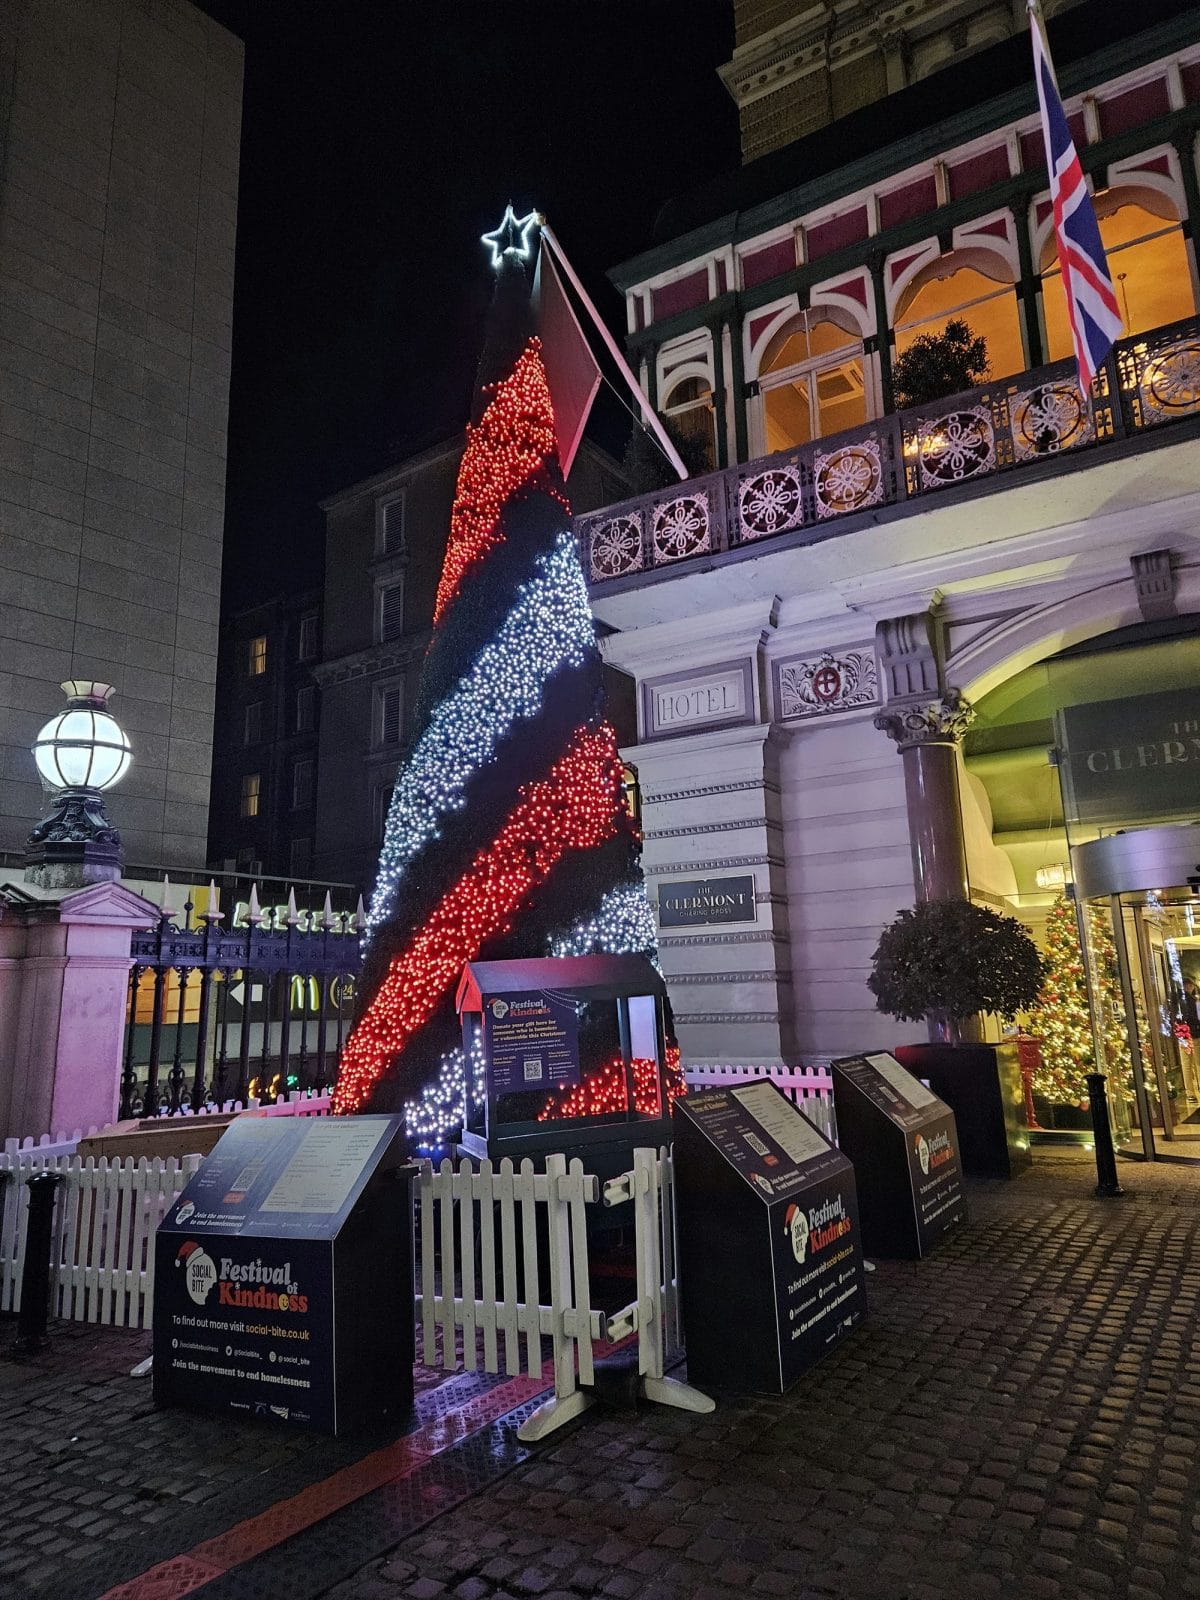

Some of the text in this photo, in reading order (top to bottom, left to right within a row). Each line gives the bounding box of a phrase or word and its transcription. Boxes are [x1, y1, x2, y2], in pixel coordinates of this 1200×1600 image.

[662, 686, 735, 720] HOTEL
[698, 886, 712, 894] THE
[665, 893, 746, 909] CLERMONT
[680, 907, 732, 917] CHARING CROSS
[510, 999, 544, 1009] Festival
[510, 1007, 551, 1017] Kindness
[808, 1193, 842, 1231] Festival
[810, 1216, 851, 1254] Kindness
[192, 1264, 212, 1279] SOCIAL
[219, 1258, 299, 1294] Festival of
[788, 1285, 794, 1295] To
[793, 1278, 802, 1291] find
[801, 1275, 809, 1286] out
[808, 1268, 819, 1281] more
[192, 1279, 204, 1292] BITE
[218, 1282, 309, 1313] Kindness
[172, 1315, 310, 1340] To find out more visit social-bite.co.uk
[791, 1328, 801, 1340] Join
[800, 1322, 808, 1333] the
[172, 1358, 311, 1388] Join the movement to end homelessness
